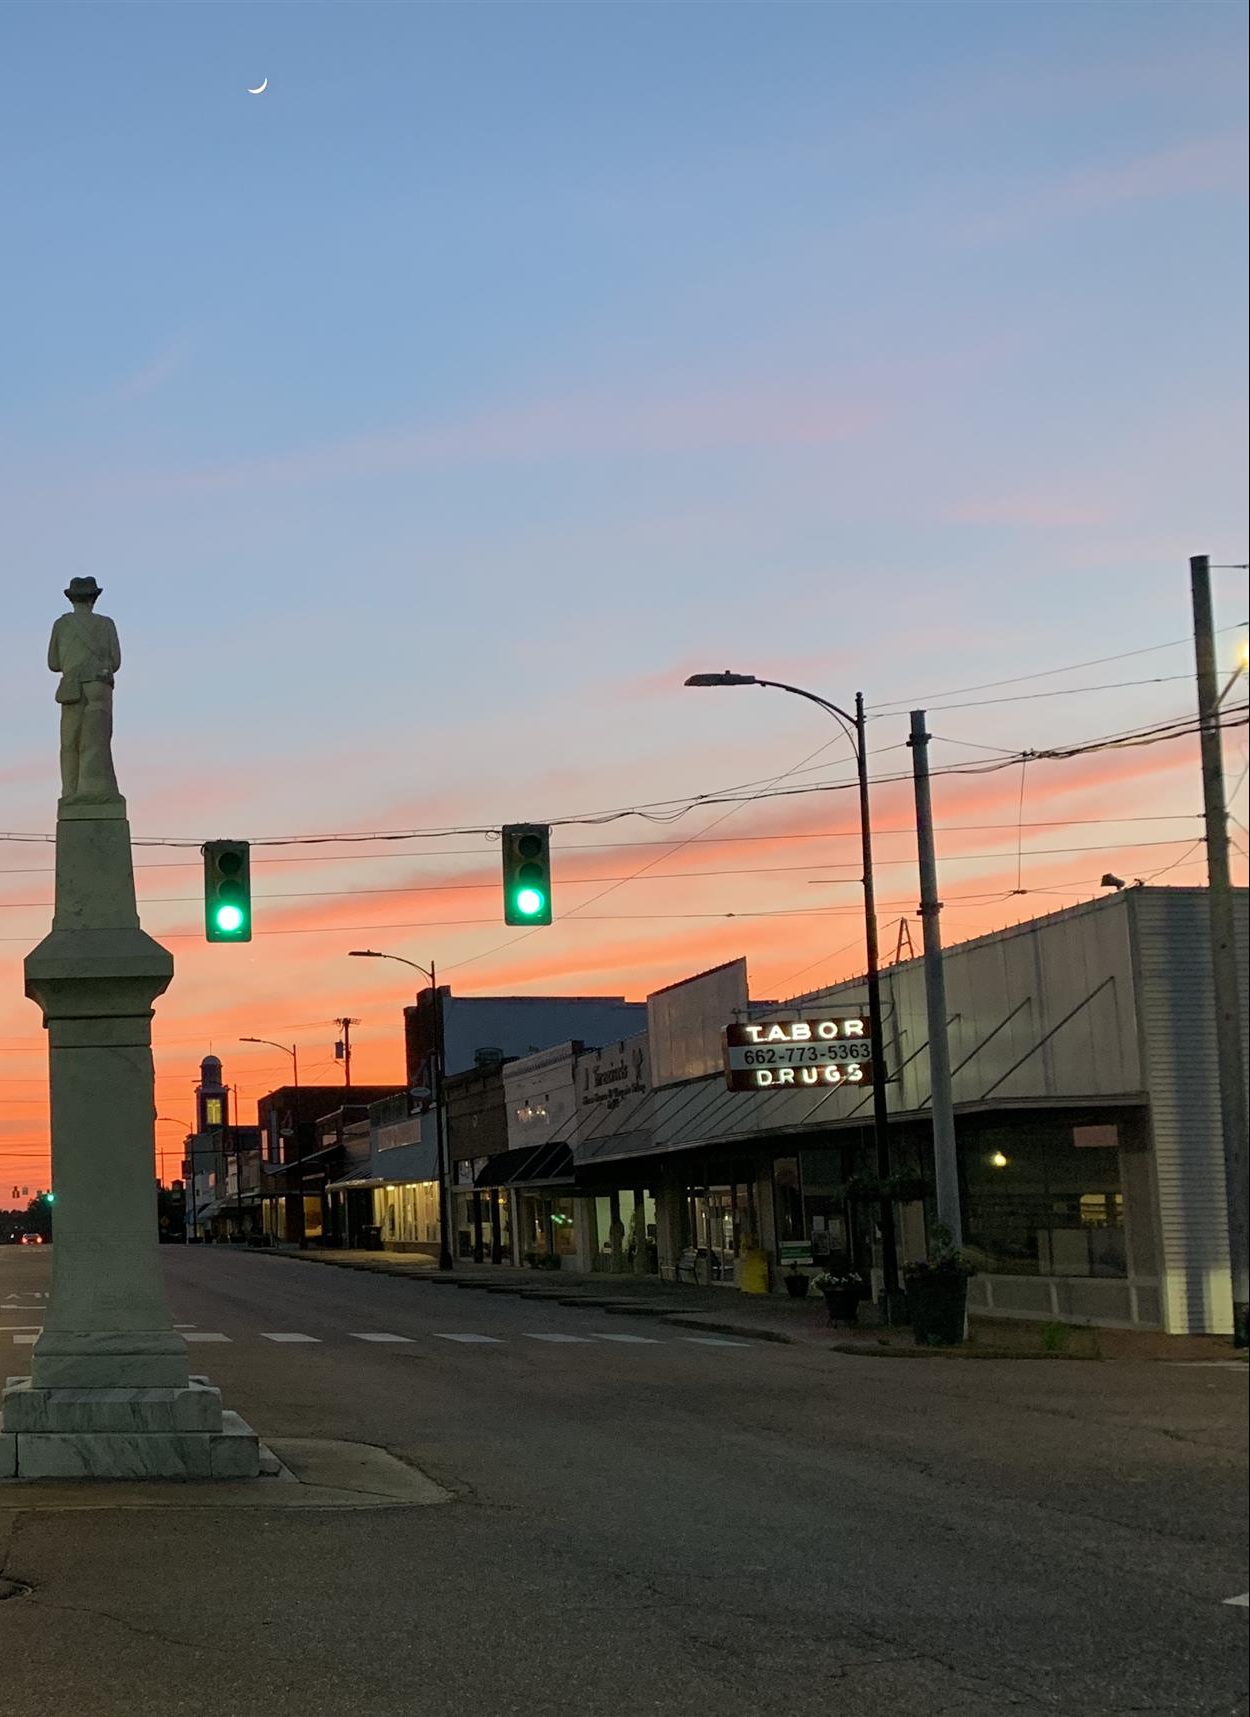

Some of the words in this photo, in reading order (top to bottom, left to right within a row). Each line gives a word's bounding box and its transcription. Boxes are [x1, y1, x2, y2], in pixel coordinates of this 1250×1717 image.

[746, 1019, 864, 1042] TABOR
[744, 1043, 871, 1065] 662-773-5363
[756, 1063, 863, 1086] DRUGS
